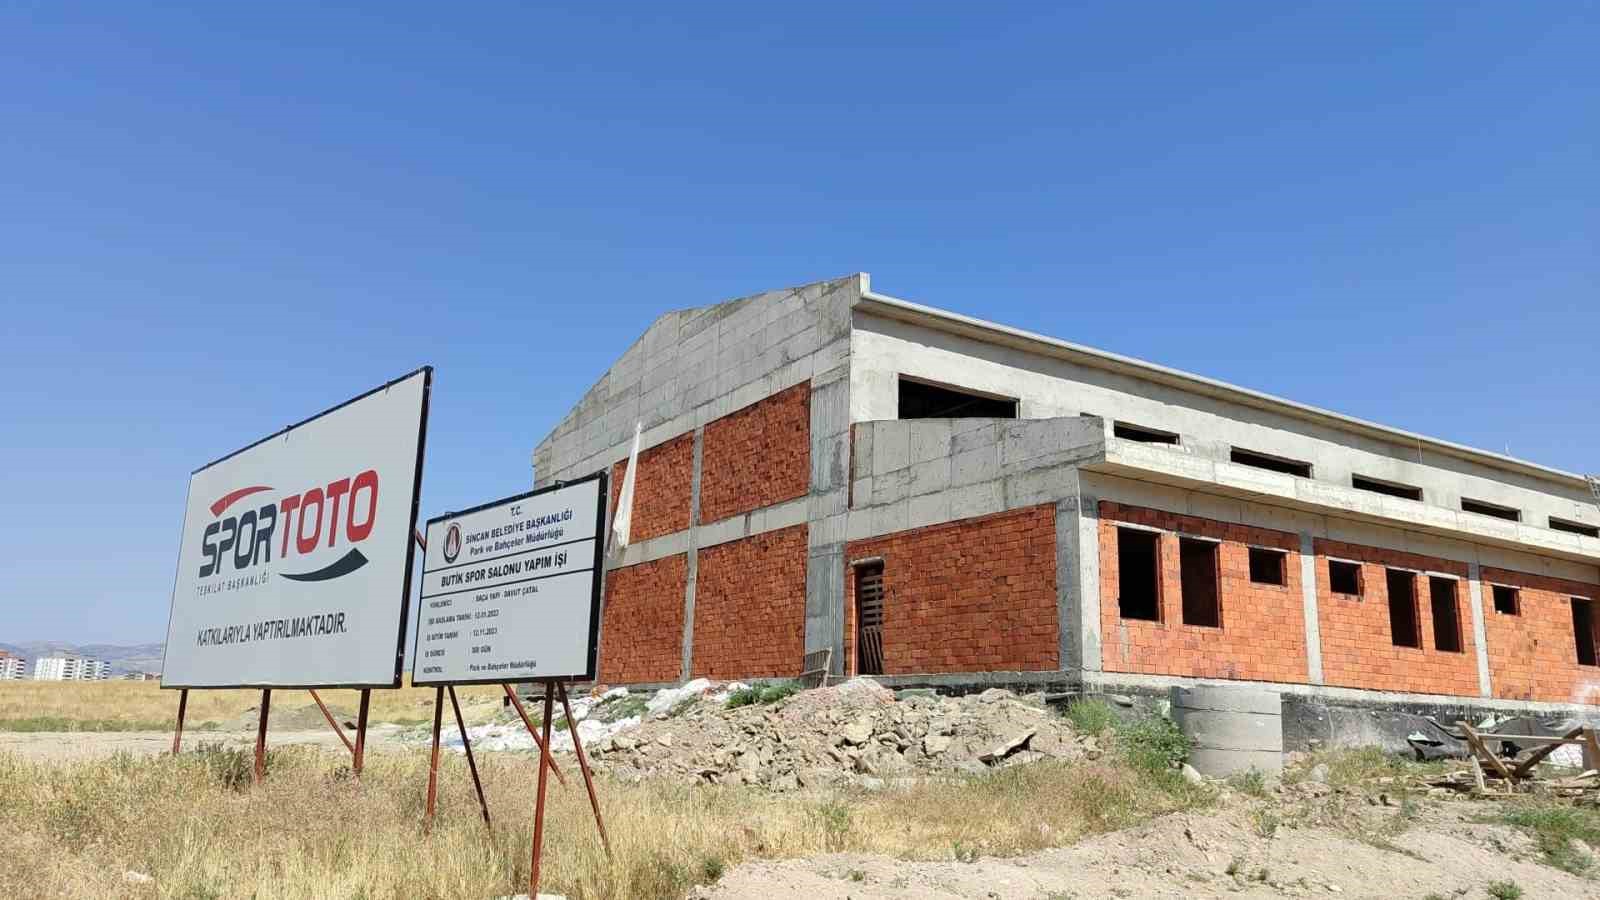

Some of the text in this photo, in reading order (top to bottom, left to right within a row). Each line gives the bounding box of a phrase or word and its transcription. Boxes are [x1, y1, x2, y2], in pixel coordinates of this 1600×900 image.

[466, 509, 573, 545] SİNCAN BELEDİYE BAŞKANLIĞI
[510, 506, 521, 516] T.C.
[470, 544, 483, 555] Park
[494, 537, 524, 552] Bahçeler
[525, 528, 564, 543] Müdürlüğü
[441, 549, 568, 587] BUTİK SPOR SALONU YAPIM İŞİ
[197, 612, 347, 647] KATKILARIYLA YAPTIRILMAKTADIR.
